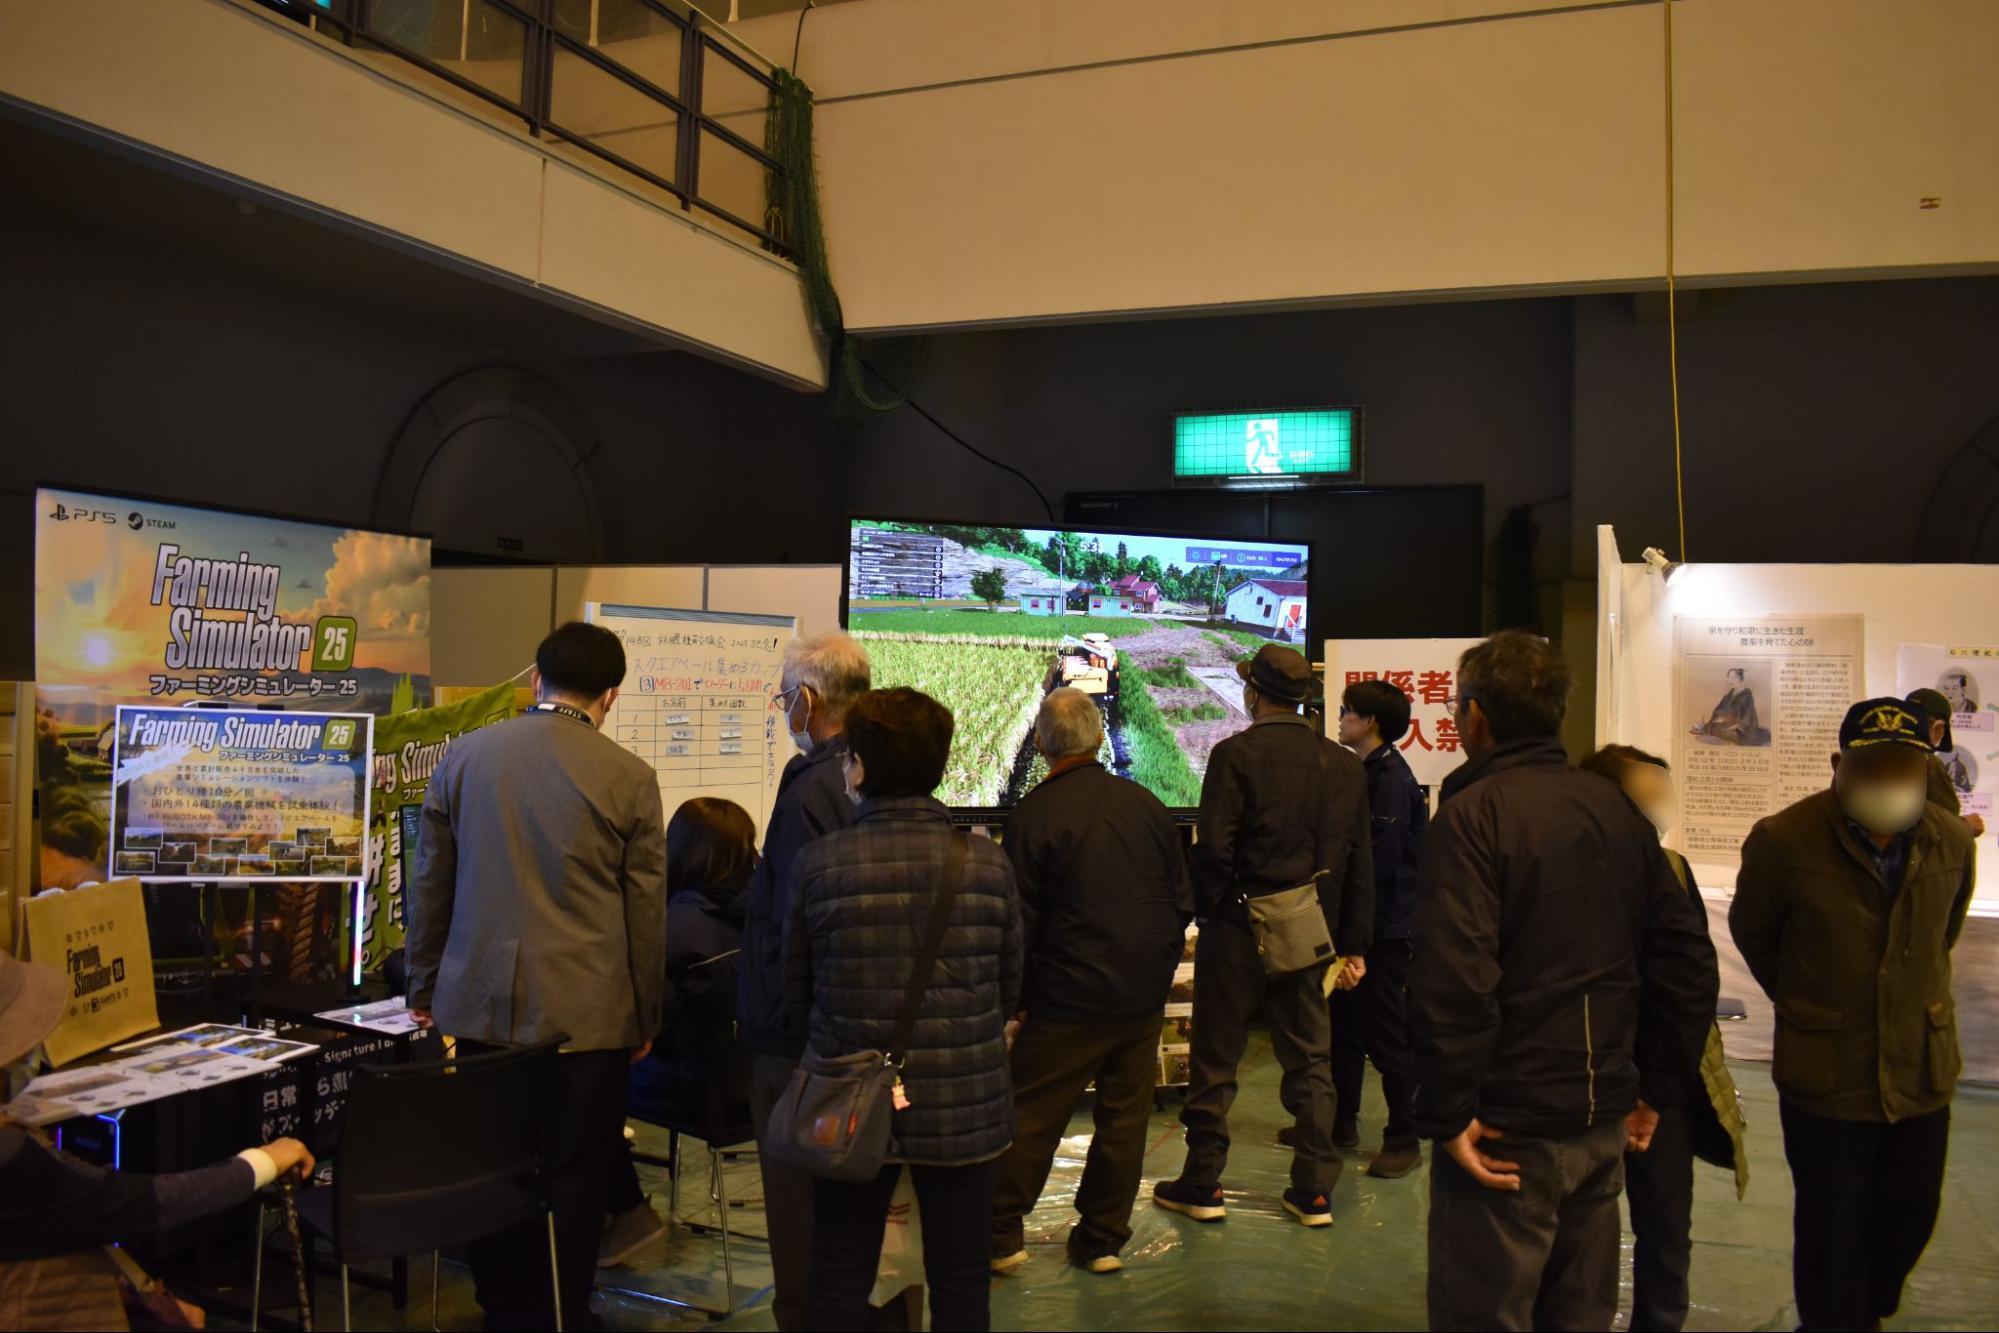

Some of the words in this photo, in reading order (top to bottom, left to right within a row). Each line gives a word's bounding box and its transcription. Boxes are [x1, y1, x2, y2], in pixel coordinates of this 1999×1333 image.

[74, 508, 117, 525] PS5
[146, 518, 177, 530] STEAM
[151, 543, 280, 622] Farming
[165, 606, 312, 672] Simulator
[321, 626, 349, 662] 25
[150, 675, 336, 696] ファーミングシミュレーター
[339, 679, 358, 695] 25
[559, 707, 582, 719] STAFF
[128, 713, 217, 753] Farming
[220, 717, 321, 752] Simulator
[329, 725, 350, 746] 25
[631, 728, 640, 740] 2
